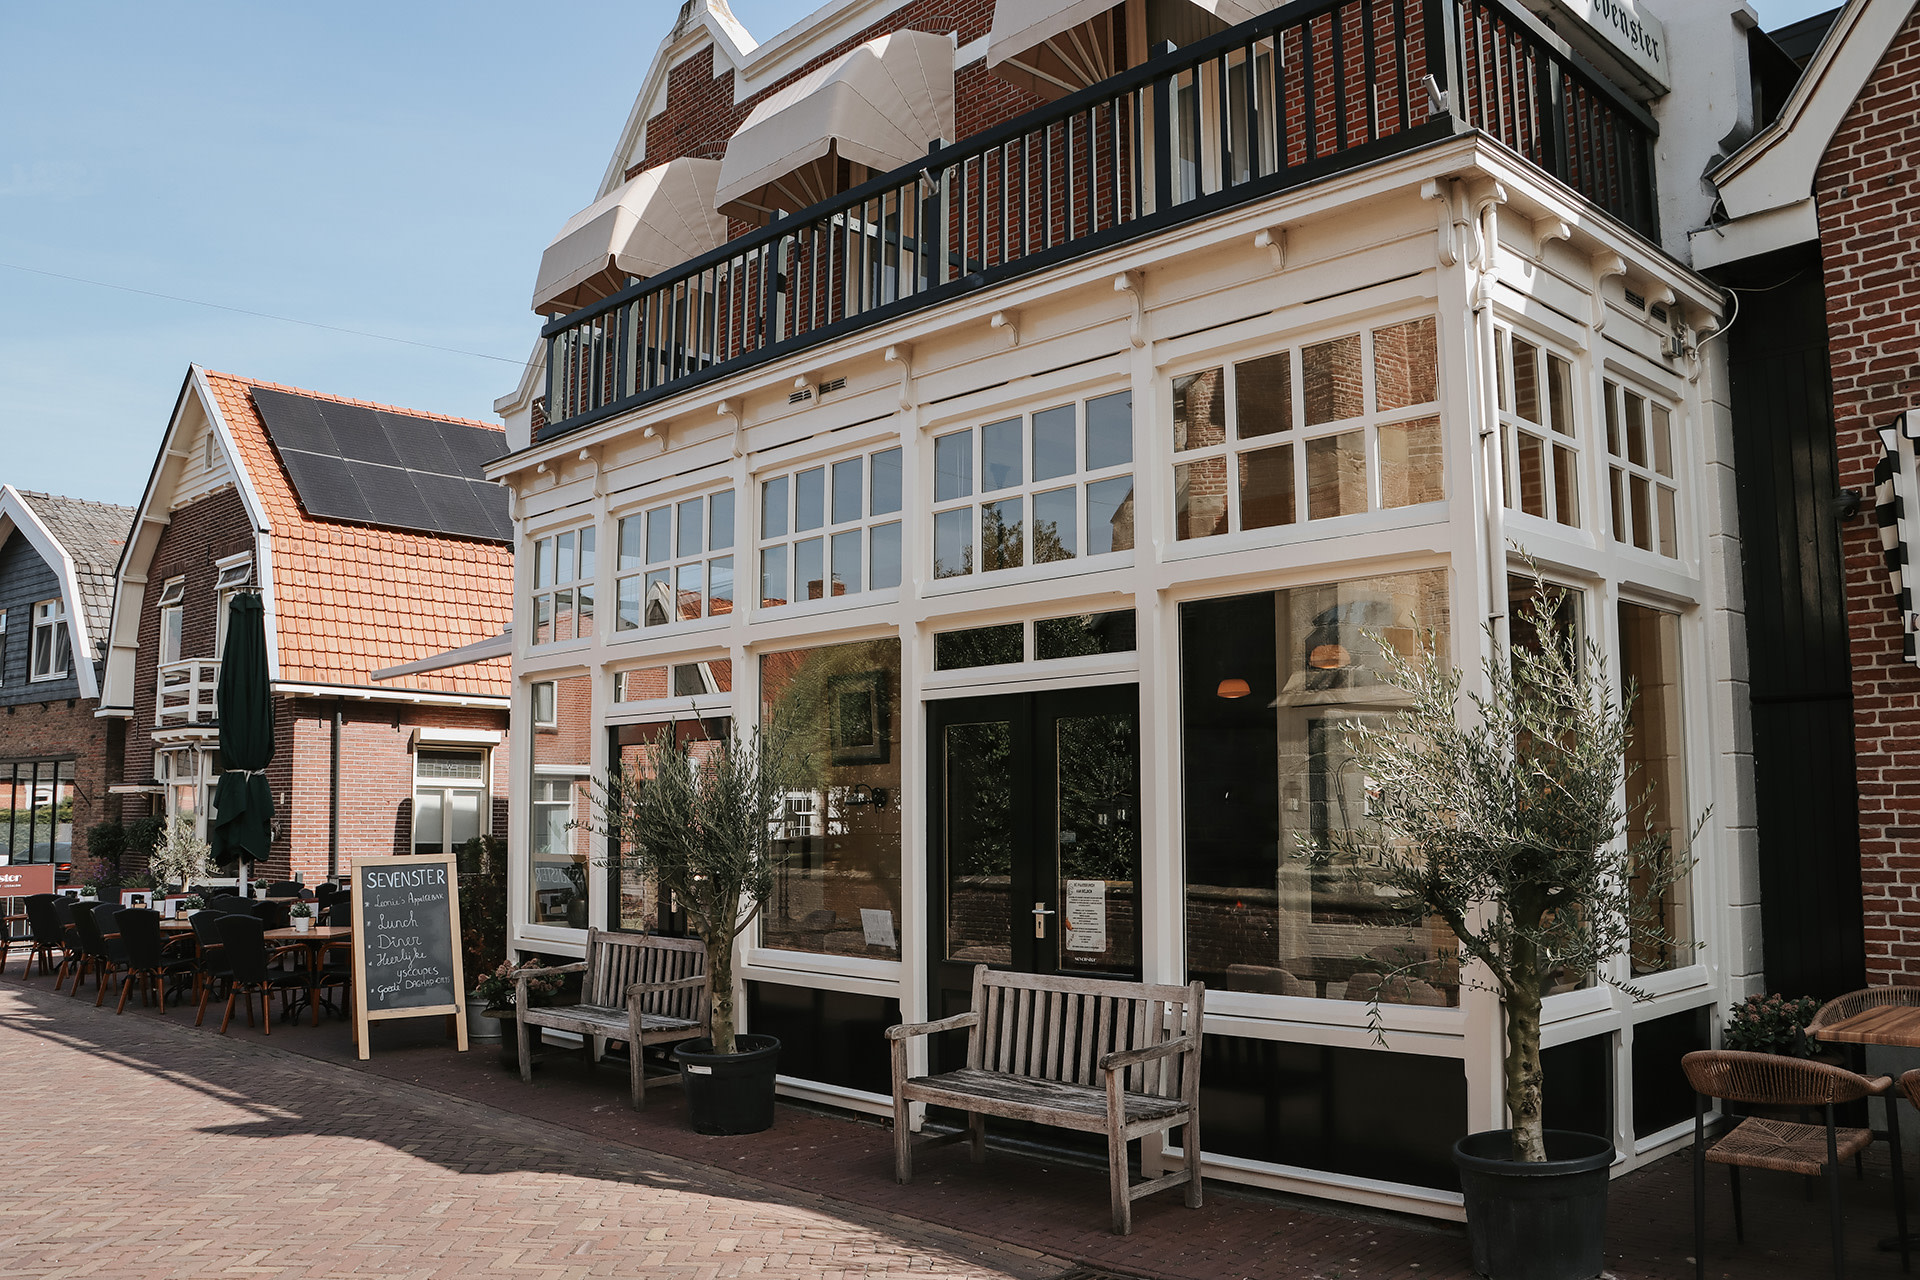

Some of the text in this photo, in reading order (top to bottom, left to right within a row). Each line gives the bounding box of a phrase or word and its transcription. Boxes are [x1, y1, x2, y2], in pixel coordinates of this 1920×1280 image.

[366, 869, 445, 888] SEVENSTER
[377, 910, 419, 930] Lunch
[376, 934, 423, 949] Diner
[376, 947, 427, 969] Heerlijke
